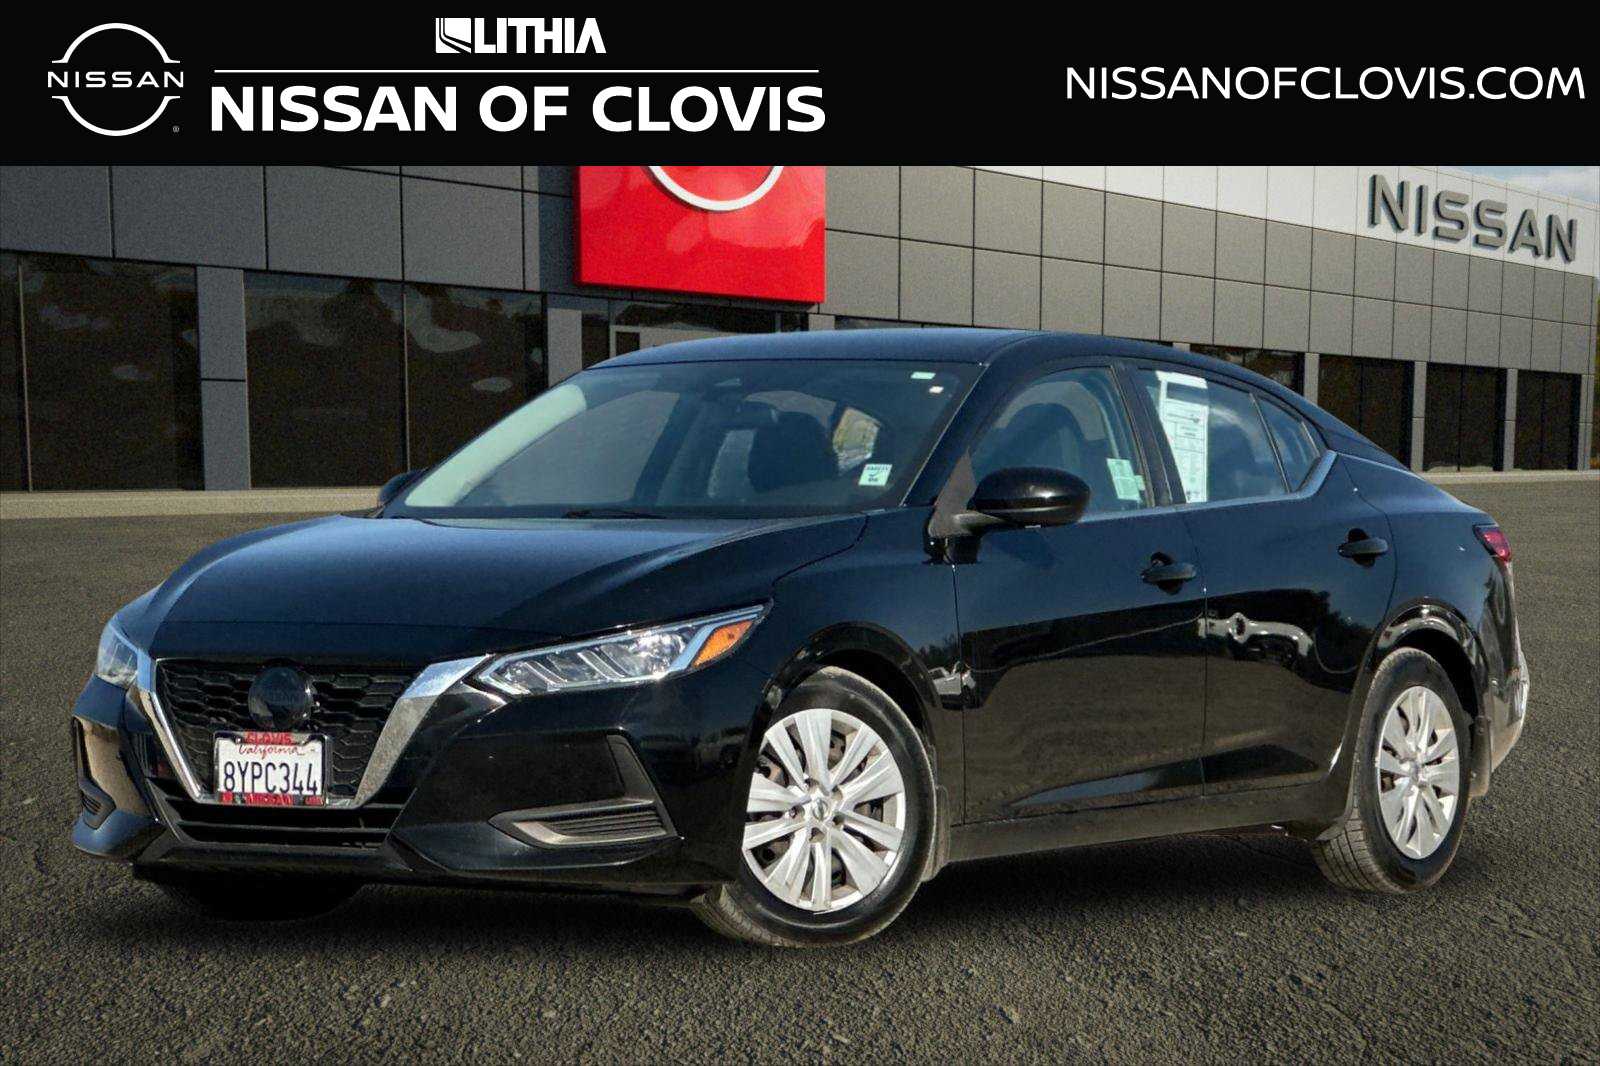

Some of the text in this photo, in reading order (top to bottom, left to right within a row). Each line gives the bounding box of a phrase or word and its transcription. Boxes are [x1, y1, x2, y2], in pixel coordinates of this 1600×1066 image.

[1367, 174, 1578, 263] NISSAN
[238, 744, 301, 760] California
[223, 761, 318, 796] 8YPC344
